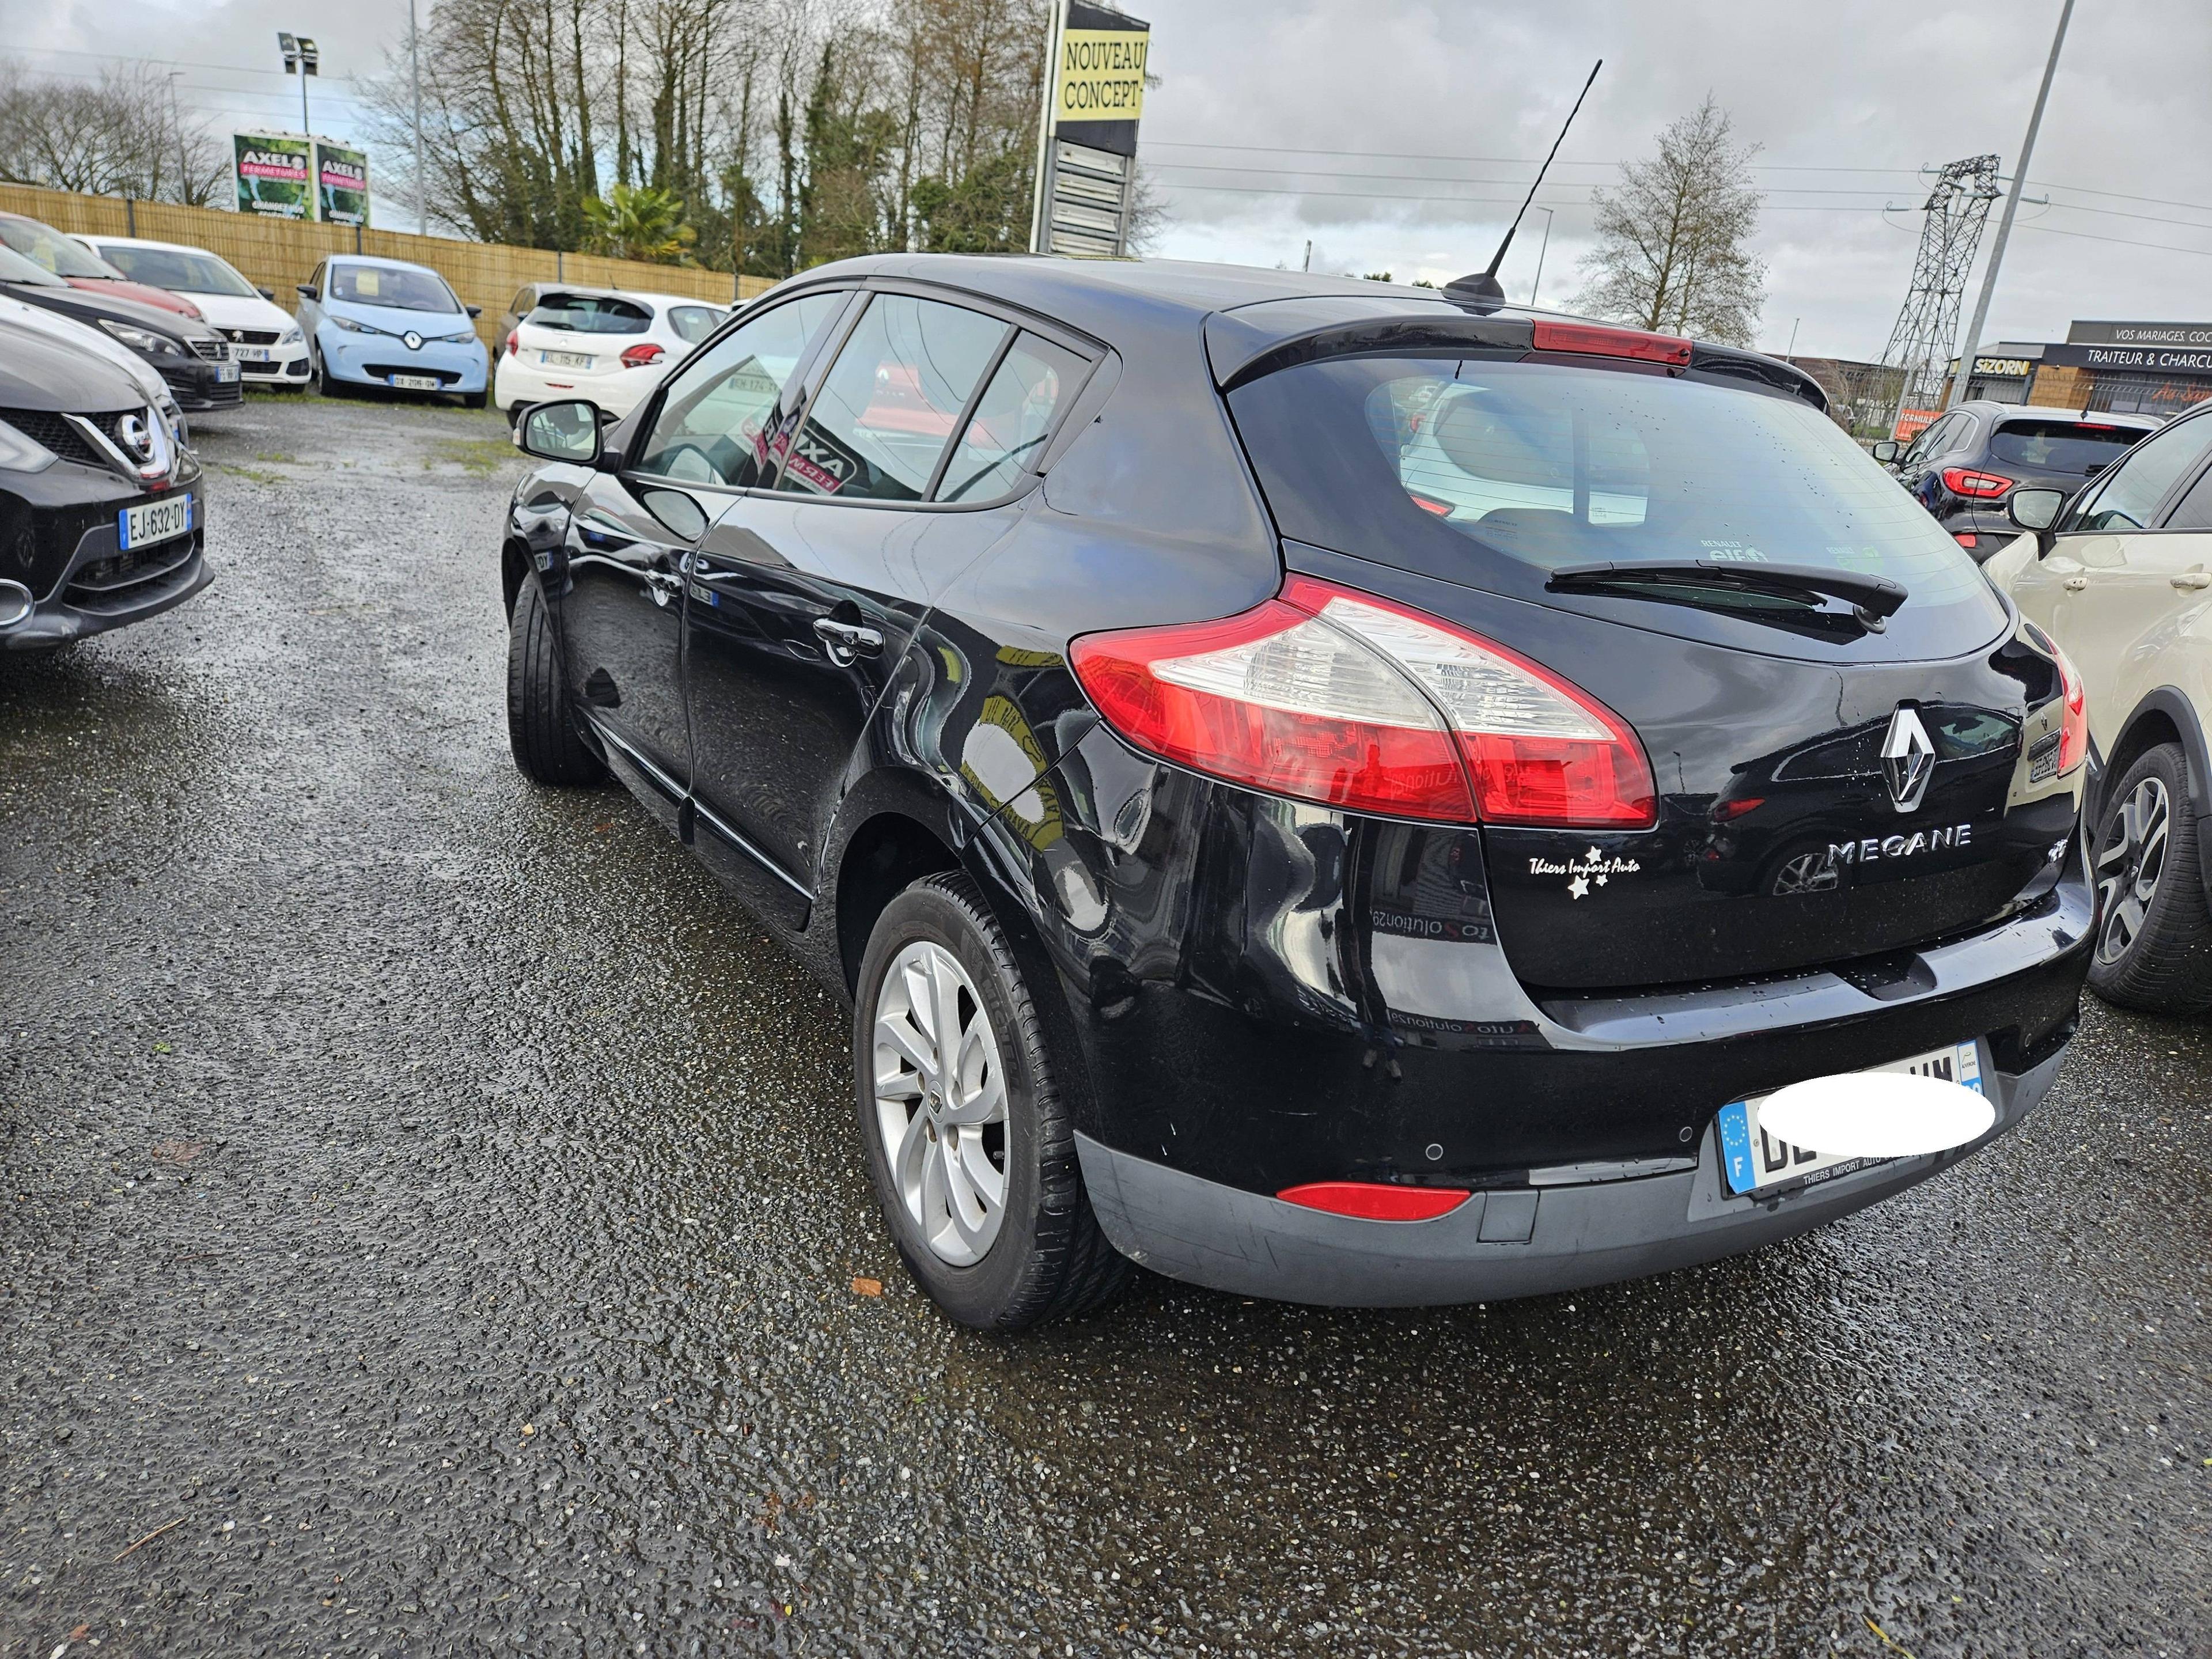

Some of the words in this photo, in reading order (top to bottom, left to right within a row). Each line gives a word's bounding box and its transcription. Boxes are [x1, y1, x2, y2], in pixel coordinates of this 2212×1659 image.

[1066, 42, 1144, 70] NOUVEAU
[1065, 80, 1139, 109] CONCEPT
[2116, 329, 2135, 340] VOS
[2088, 349, 2143, 365] TRAITEUR
[2146, 353, 2155, 365] &
[1710, 549, 1745, 562] elf
[1827, 824, 1971, 866] MEGANE
[1529, 858, 1567, 874] Thiers
[1569, 858, 1611, 878] Import
[1611, 857, 1641, 873] Auto
[1733, 1156, 1743, 1177] F
[1804, 1170, 1830, 1185] THIERS
[1833, 1160, 1860, 1177] IMPORT
[1863, 1157, 1882, 1168] AUTO
